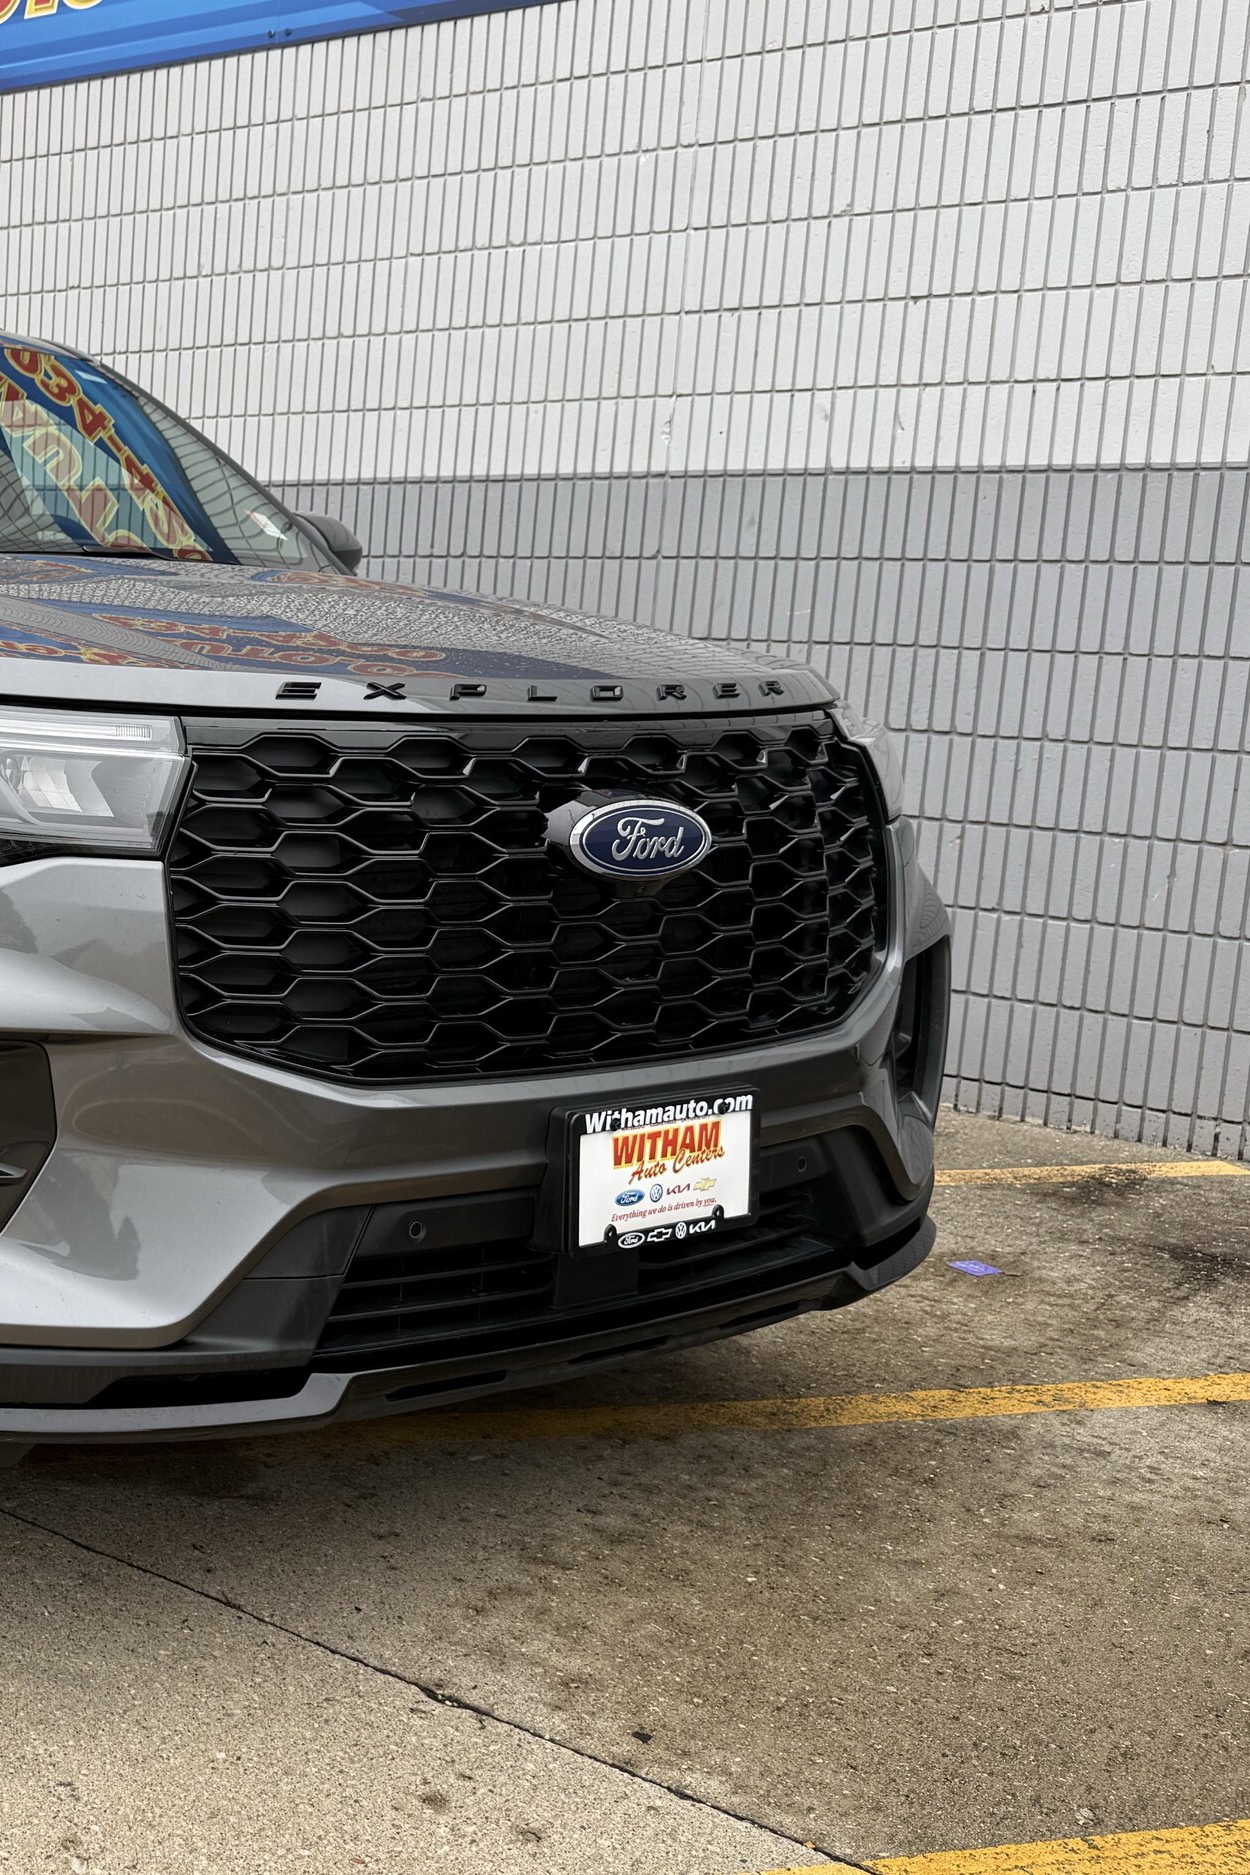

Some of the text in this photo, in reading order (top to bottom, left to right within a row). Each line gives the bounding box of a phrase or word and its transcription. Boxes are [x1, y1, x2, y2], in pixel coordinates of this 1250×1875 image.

[275, 680, 785, 703] EXPLORER
[611, 816, 685, 862] Ford
[612, 1120, 721, 1168] WITHAM
[628, 1145, 725, 1185] Auto Centers
[611, 1209, 647, 1222] Everything
[667, 1203, 673, 1211] is
[674, 1201, 694, 1210] driven
[695, 1198, 703, 1207] by
